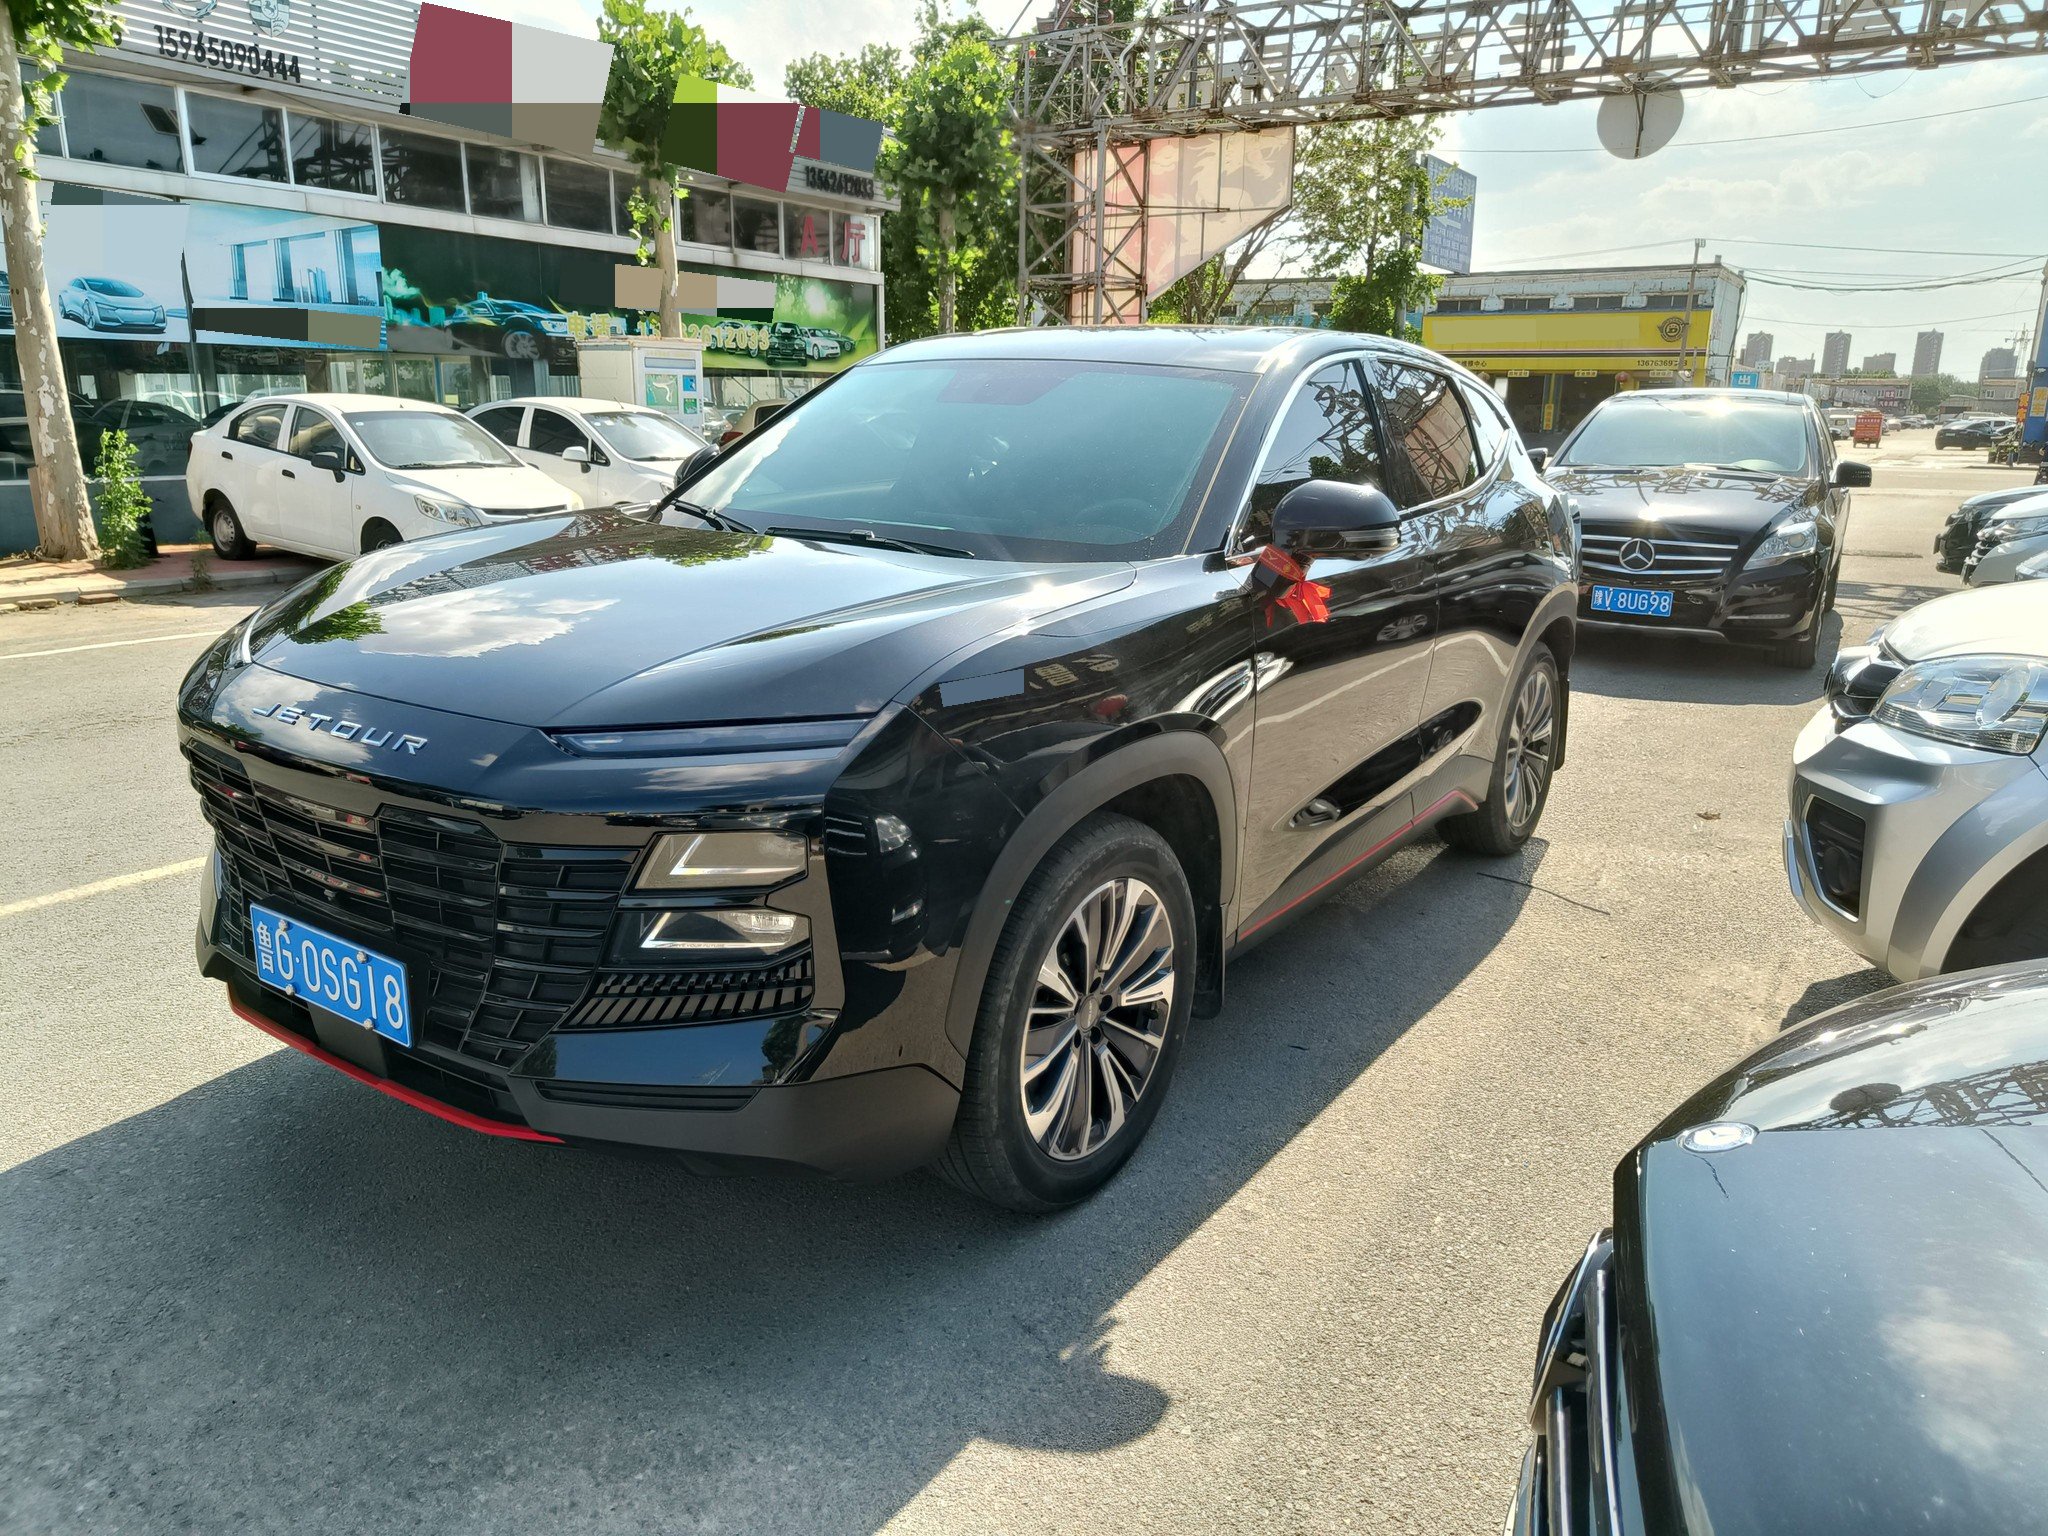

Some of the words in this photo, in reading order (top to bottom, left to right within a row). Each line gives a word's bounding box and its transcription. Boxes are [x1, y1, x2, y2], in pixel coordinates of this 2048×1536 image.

[153, 24, 301, 83] 15965090444
[801, 215, 819, 258] A
[840, 220, 866, 264] 厅
[252, 703, 428, 755] JETOUR
